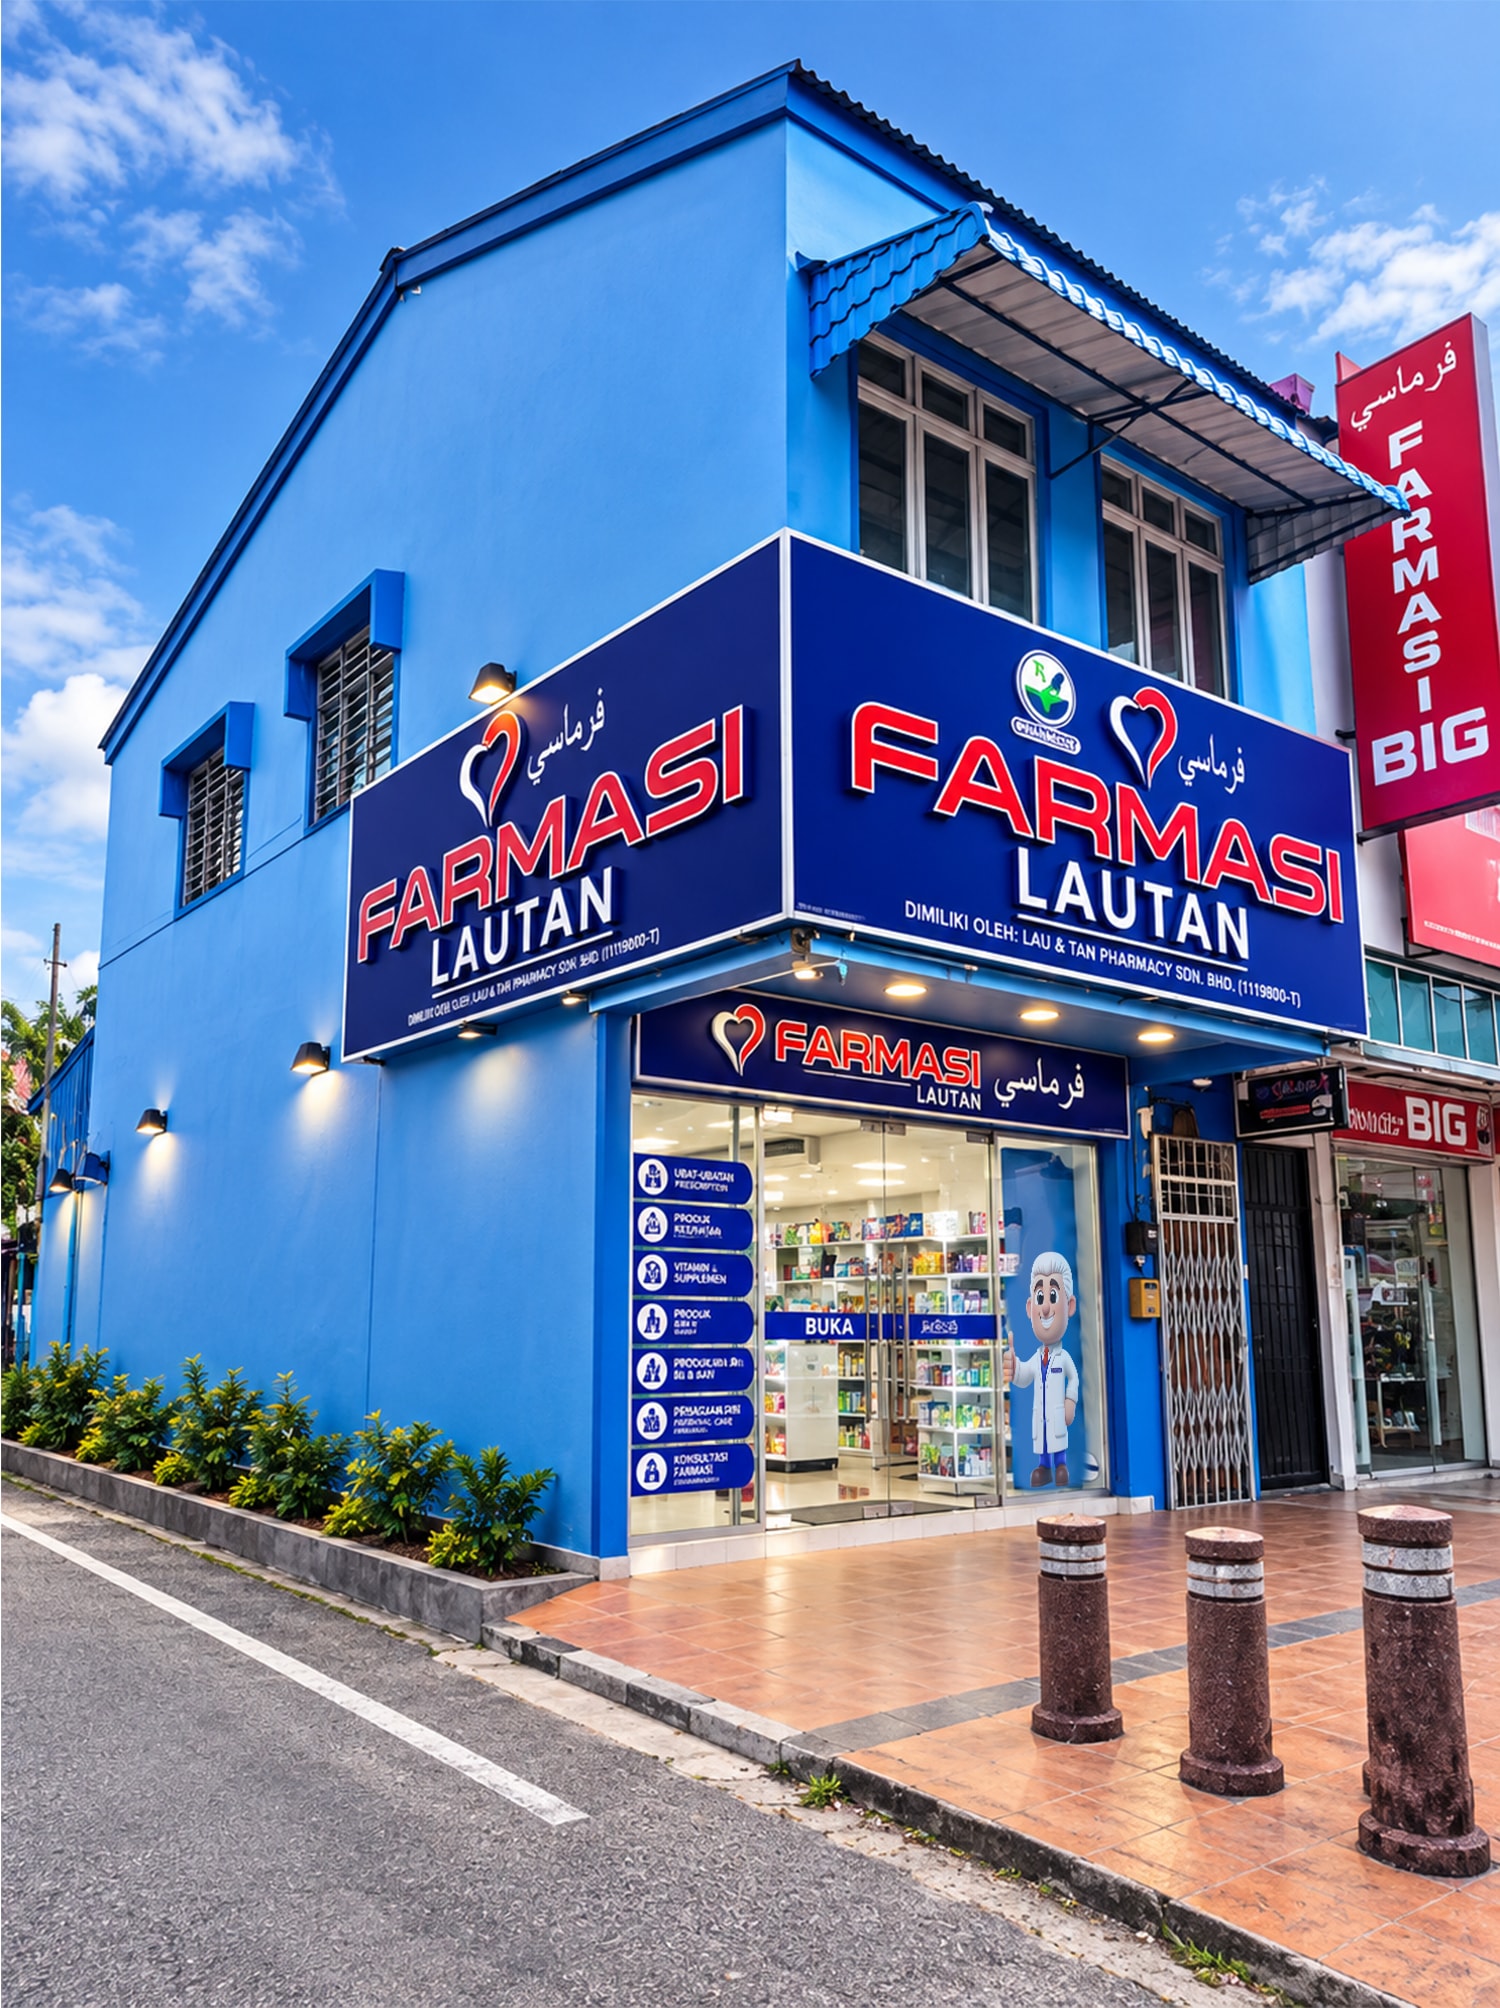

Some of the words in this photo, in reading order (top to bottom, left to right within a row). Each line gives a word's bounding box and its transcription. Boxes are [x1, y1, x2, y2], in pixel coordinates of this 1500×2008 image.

[1351, 341, 1458, 432] فرماسي
[1388, 419, 1443, 713] FARMASI
[526, 688, 606, 786] فرماسي
[1177, 734, 1247, 794] فرماسي
[1371, 706, 1490, 787] BIG
[357, 704, 744, 964] FARMASI
[850, 700, 1345, 925] FARMASI
[431, 865, 614, 988] LAUTAN
[904, 899, 969, 931] DIMILIKI
[972, 917, 1019, 943] OLEH:
[1022, 928, 1051, 951] LAU
[1054, 936, 1066, 954] &
[1068, 940, 1097, 962] TAN
[1100, 947, 1173, 978] PHARMACY
[1017, 846, 1250, 961] LAUTAN
[774, 1019, 982, 1089] FARMASI
[993, 1058, 1086, 1109] فرماسي
[916, 1083, 982, 1111] LAUTAN
[1405, 1095, 1467, 1146] BIG
[805, 1317, 854, 1336] BUKA
